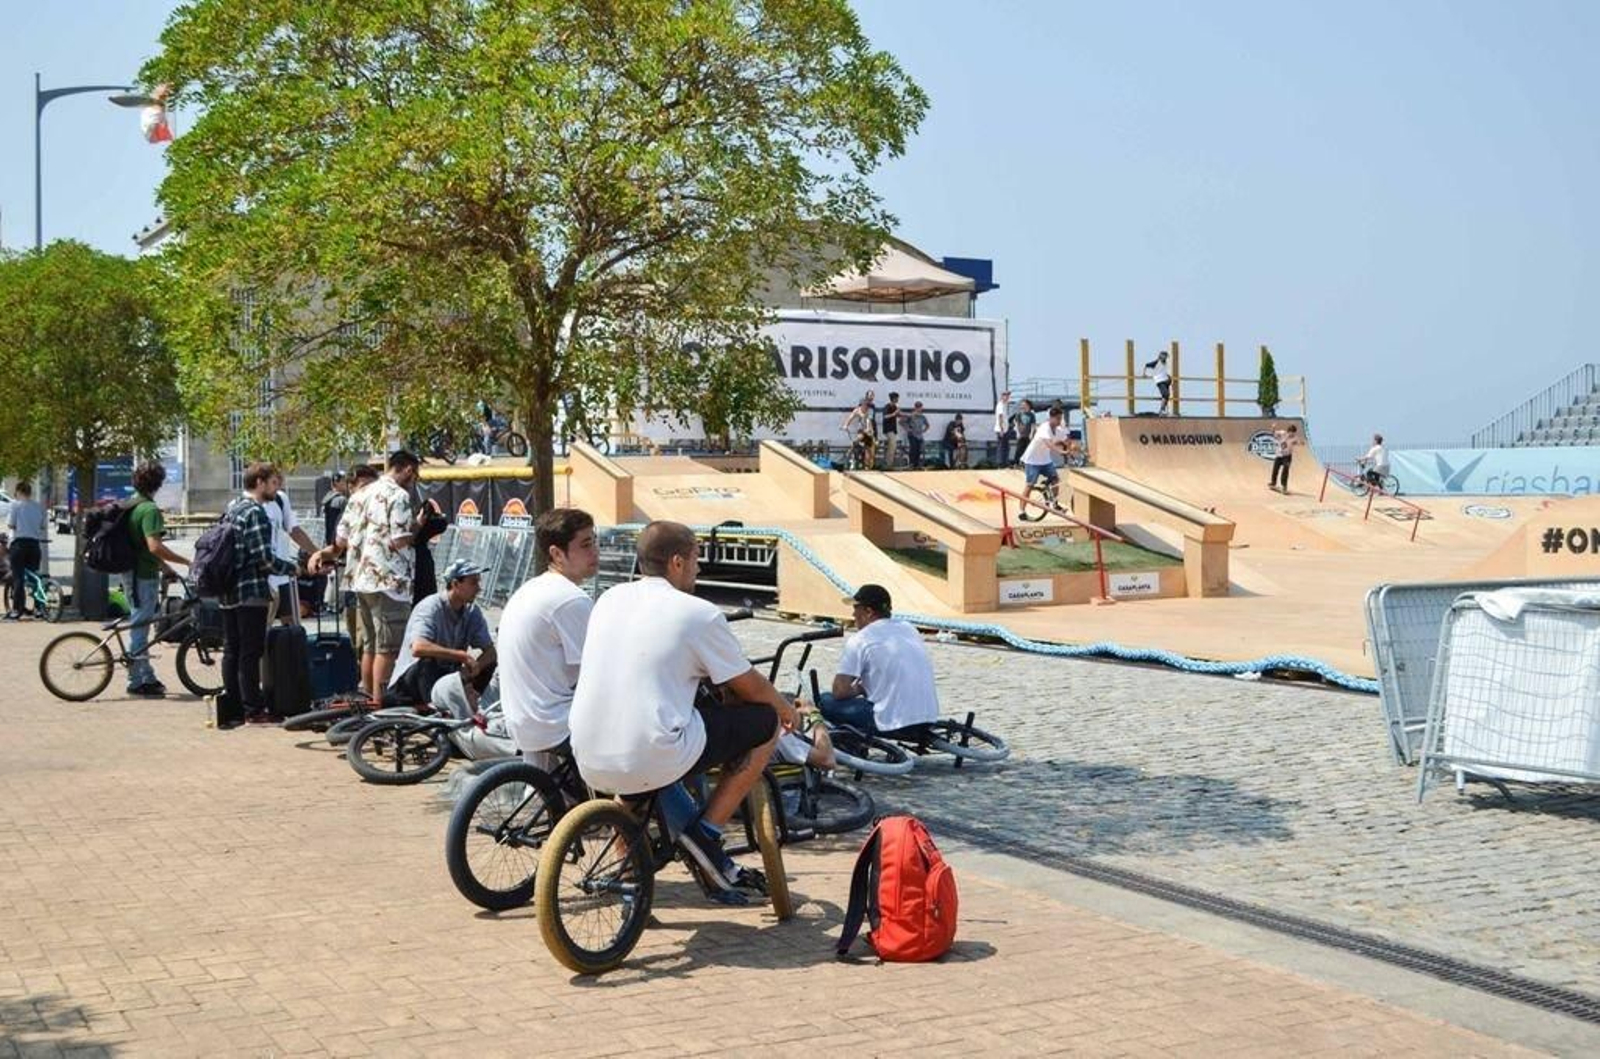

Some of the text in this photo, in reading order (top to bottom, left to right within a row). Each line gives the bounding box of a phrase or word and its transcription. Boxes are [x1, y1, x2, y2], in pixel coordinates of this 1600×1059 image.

[768, 345, 971, 383] ARISQUINO
[1139, 434, 1223, 446] O MARISQUINO
[652, 486, 741, 496] GoPro
[1020, 527, 1073, 539] GoPro
